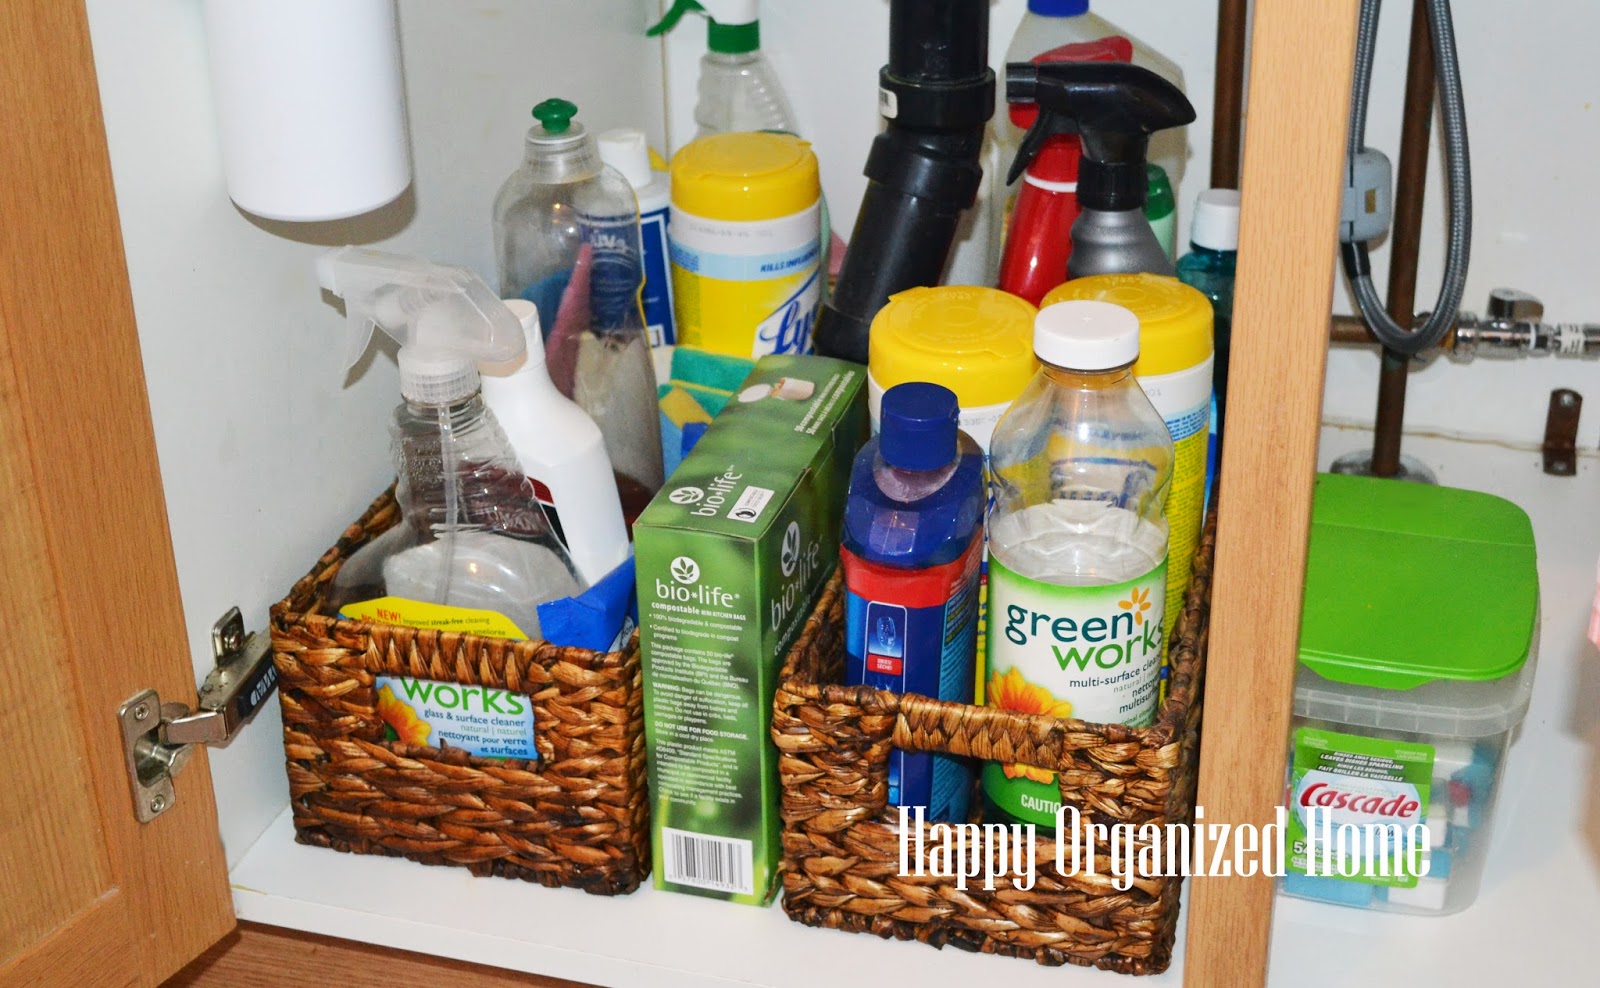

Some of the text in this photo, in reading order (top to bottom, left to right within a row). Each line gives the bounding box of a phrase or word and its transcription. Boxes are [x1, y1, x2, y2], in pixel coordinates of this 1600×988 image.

[760, 262, 785, 273] KILLS
[376, 608, 402, 621] NEW!
[651, 601, 699, 615] compostable
[712, 611, 732, 619] KITCHEN
[431, 617, 464, 626] streak-free
[465, 617, 490, 625] cleaning
[668, 616, 703, 626] biodegradable
[710, 623, 742, 632] compostable
[1005, 603, 1133, 646] green
[1069, 667, 1140, 688] multi-surface
[1113, 679, 1142, 694] natural
[399, 676, 525, 716] works
[424, 709, 526, 727] glass & surface cleaner
[438, 729, 528, 746] nettoyant pour verre
[461, 724, 527, 736] natural naturel
[480, 745, 528, 756] et surfaces
[1333, 752, 1353, 760] RINSES
[1320, 754, 1404, 771] LEAVES DISHES SPARKLING
[1318, 765, 1332, 773] FAIT
[1333, 768, 1359, 777] BRILLER
[1370, 773, 1403, 782] VAISSELLE
[1299, 782, 1420, 819] Cascade
